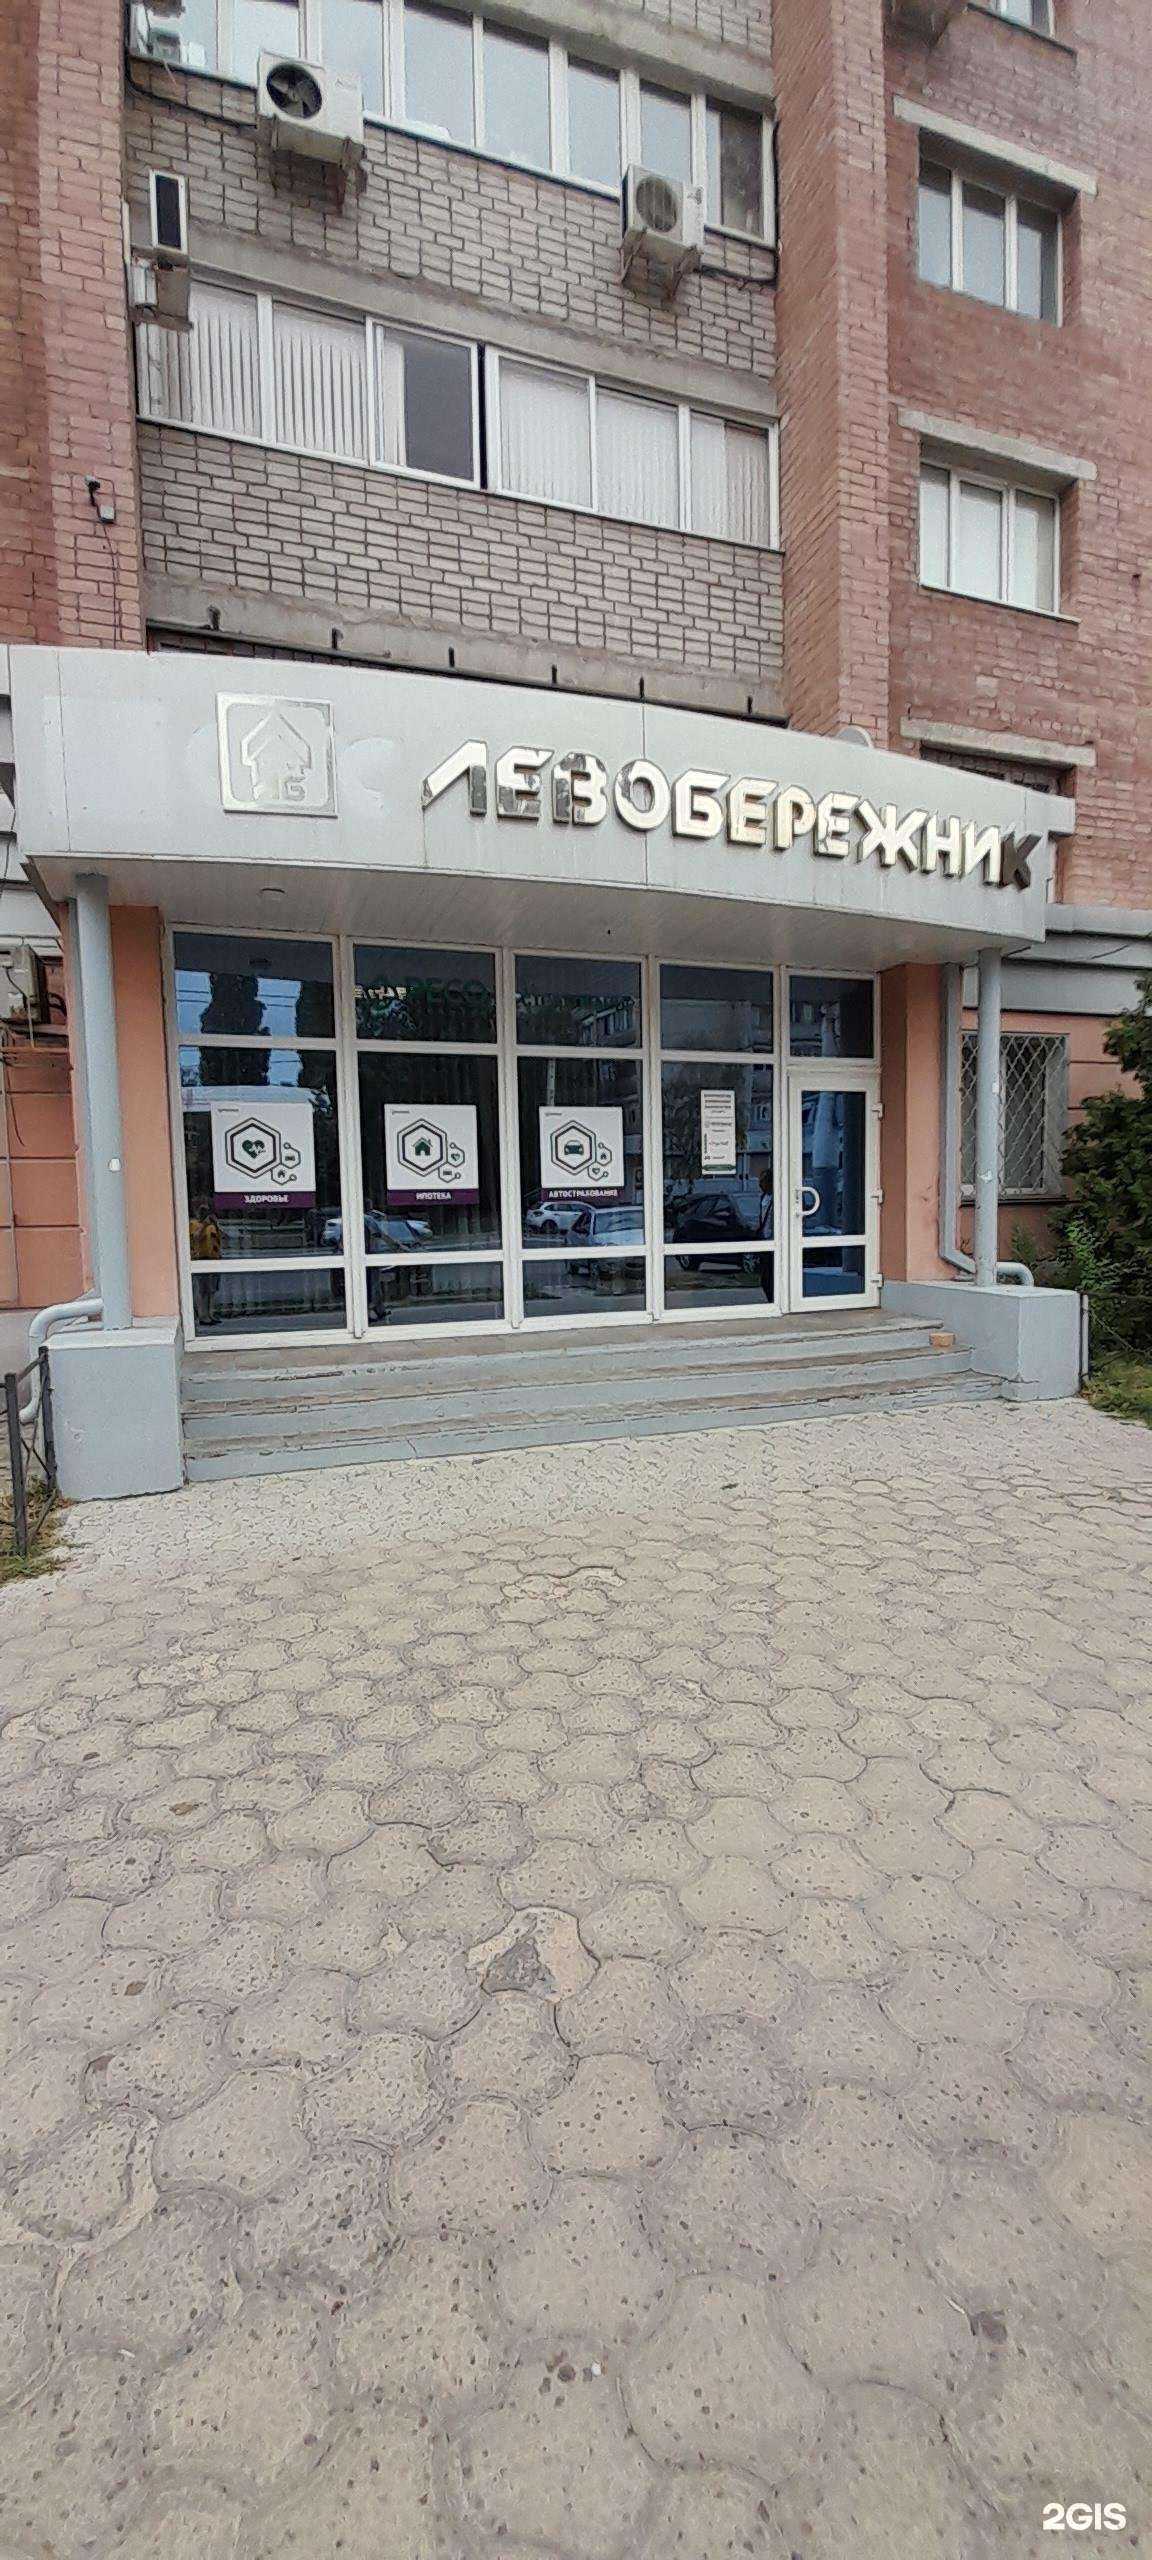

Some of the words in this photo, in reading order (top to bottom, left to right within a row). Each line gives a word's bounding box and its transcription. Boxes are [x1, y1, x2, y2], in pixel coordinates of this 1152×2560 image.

[421, 739, 1041, 890] ЛЕВОБЕРЕЖНИК
[244, 1194, 289, 1203] ЗДОРОВЬЕ
[415, 1191, 452, 1201] ИПОТЕКА
